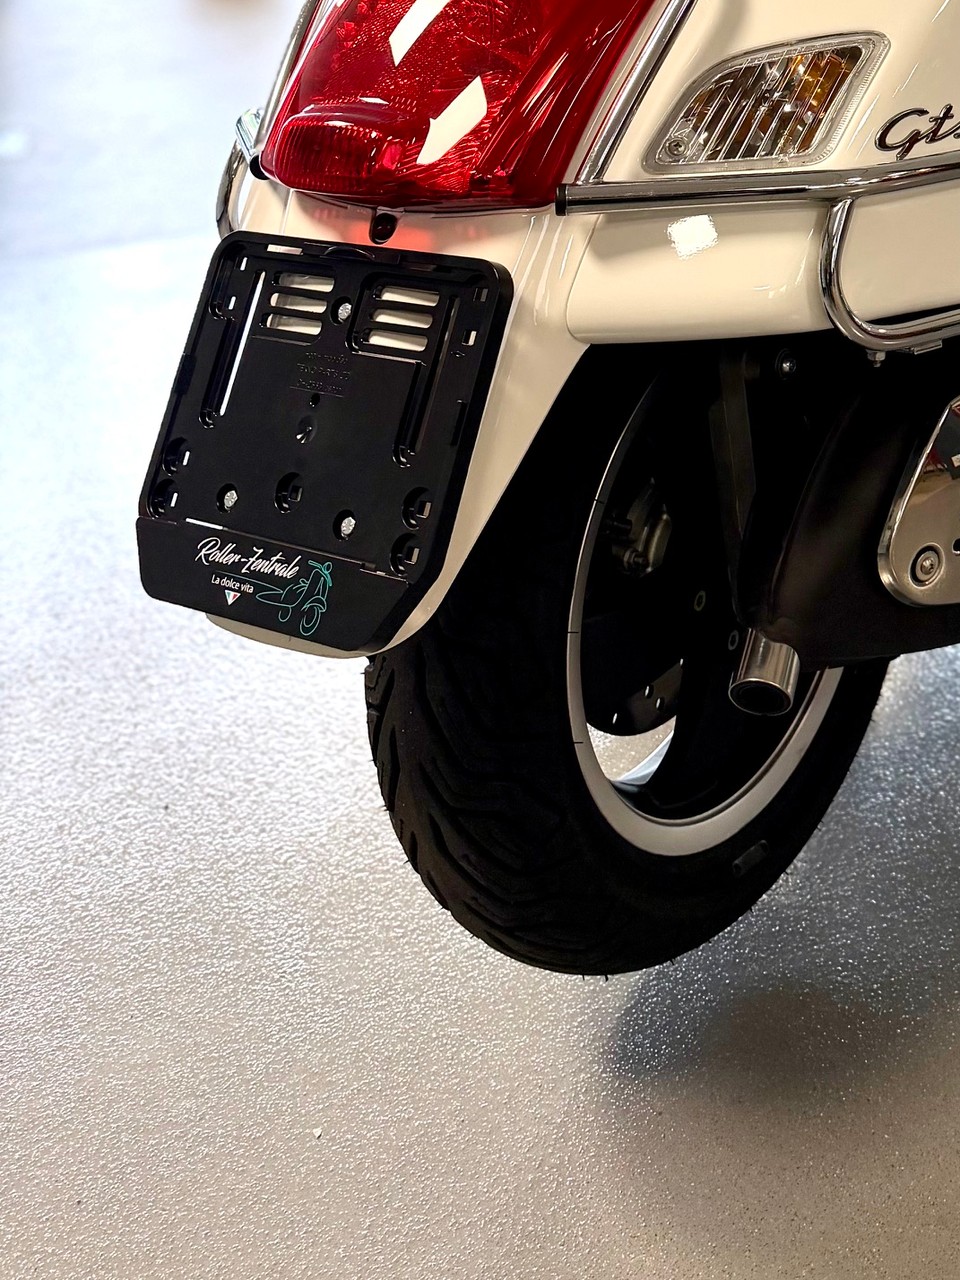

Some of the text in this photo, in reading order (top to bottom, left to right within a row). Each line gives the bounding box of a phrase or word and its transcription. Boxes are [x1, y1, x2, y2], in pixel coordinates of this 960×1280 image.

[195, 537, 301, 579] Roller-Zentrale
[211, 574, 254, 593] La dolce vita
